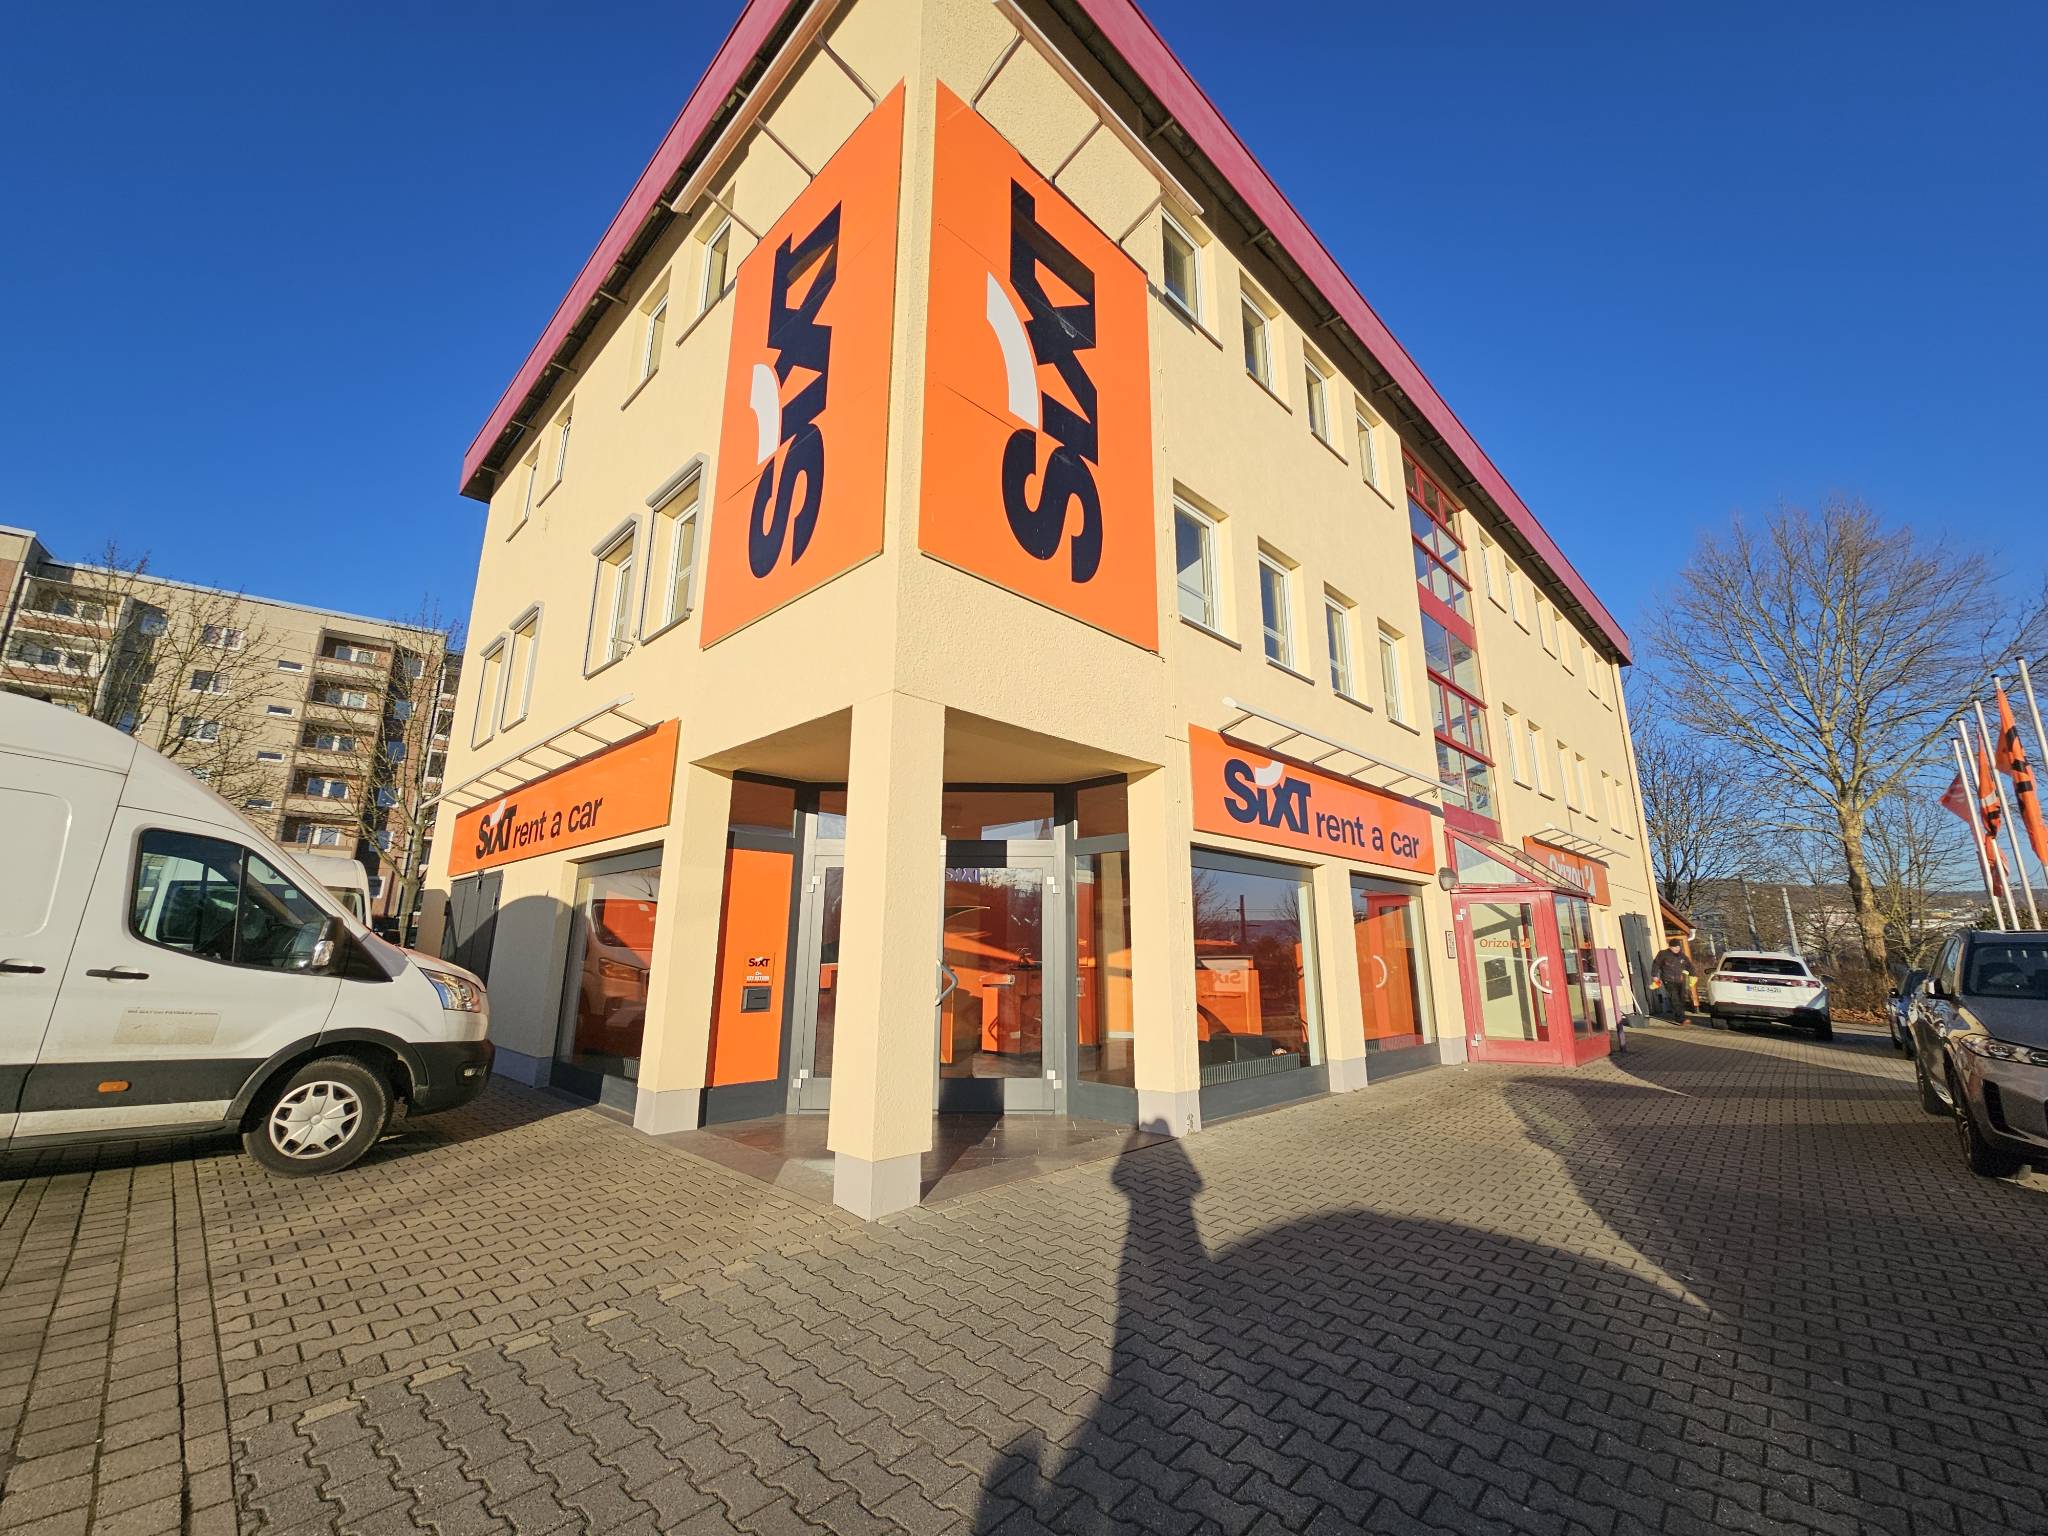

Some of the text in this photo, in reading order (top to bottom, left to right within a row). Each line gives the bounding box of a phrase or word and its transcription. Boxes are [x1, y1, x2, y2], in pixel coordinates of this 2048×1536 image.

[512, 810, 547, 849] rent
[550, 811, 562, 839] a
[567, 797, 604, 833] car
[1315, 811, 1366, 848] rent
[1371, 826, 1385, 852] a
[1390, 830, 1420, 860] car
[1479, 937, 1518, 949] Orizon
